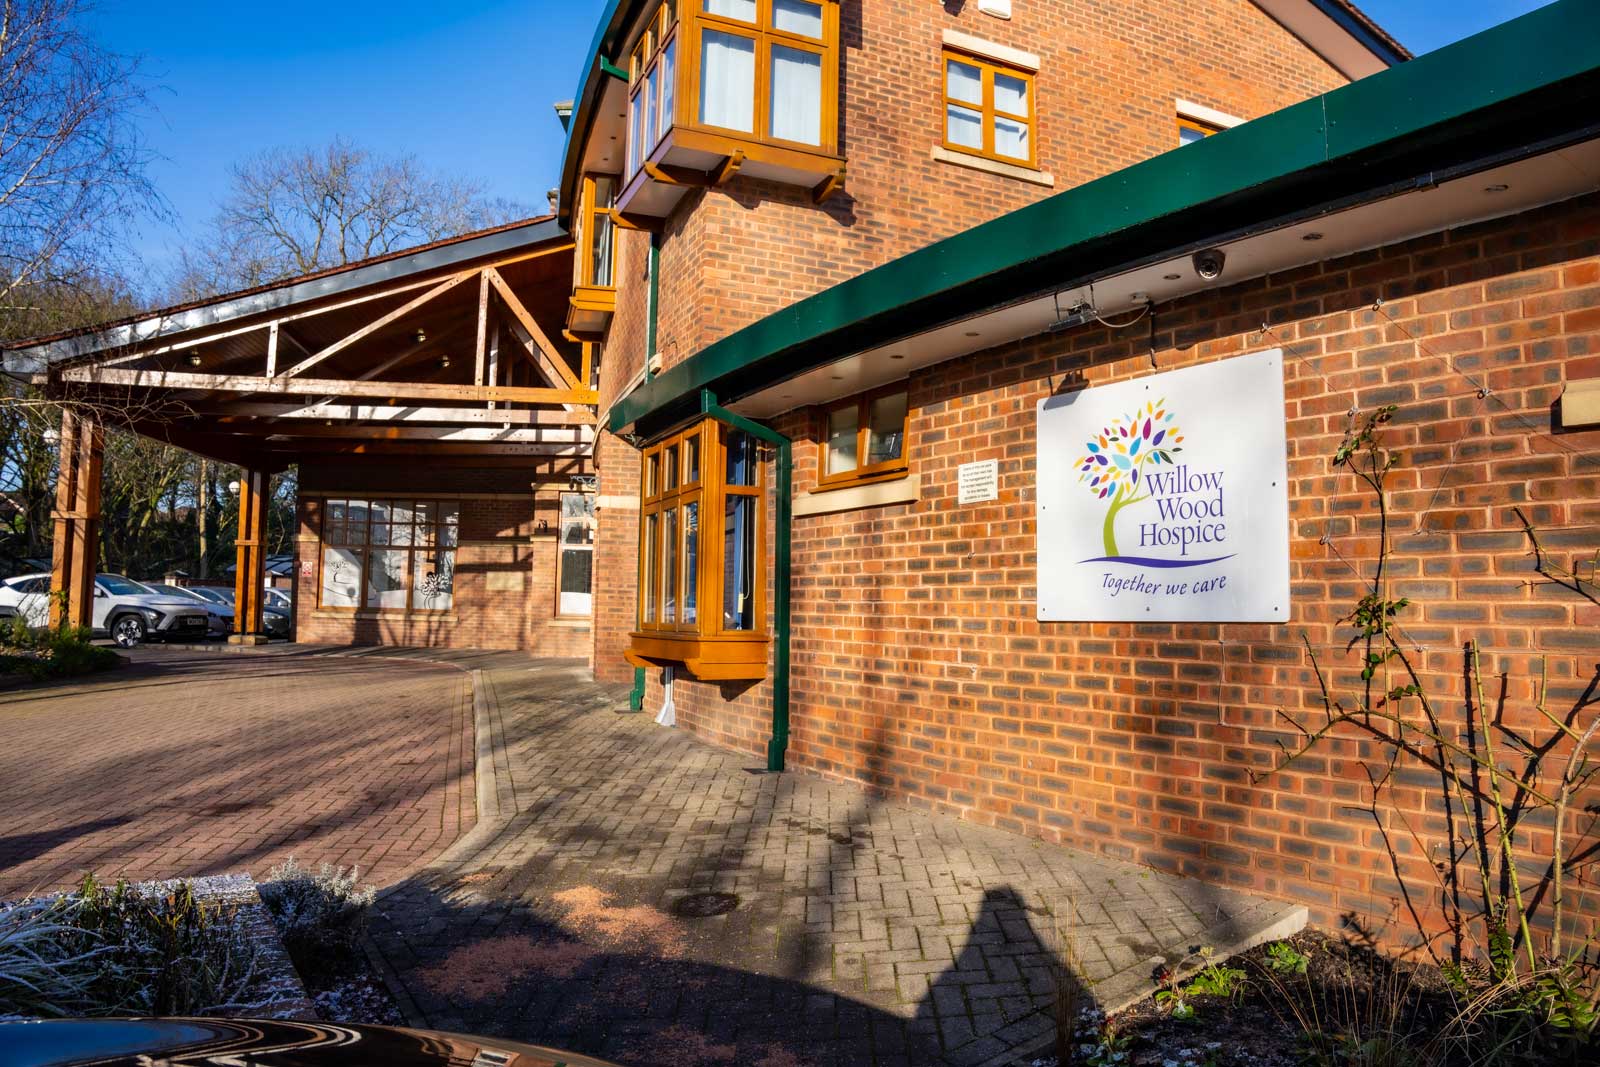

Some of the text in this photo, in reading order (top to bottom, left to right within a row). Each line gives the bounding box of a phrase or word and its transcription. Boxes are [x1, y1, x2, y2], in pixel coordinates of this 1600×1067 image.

[1145, 465, 1224, 496] Willow
[1157, 488, 1224, 521] Wood
[1139, 521, 1225, 556] Hospice
[1102, 573, 1227, 597] Together we care
